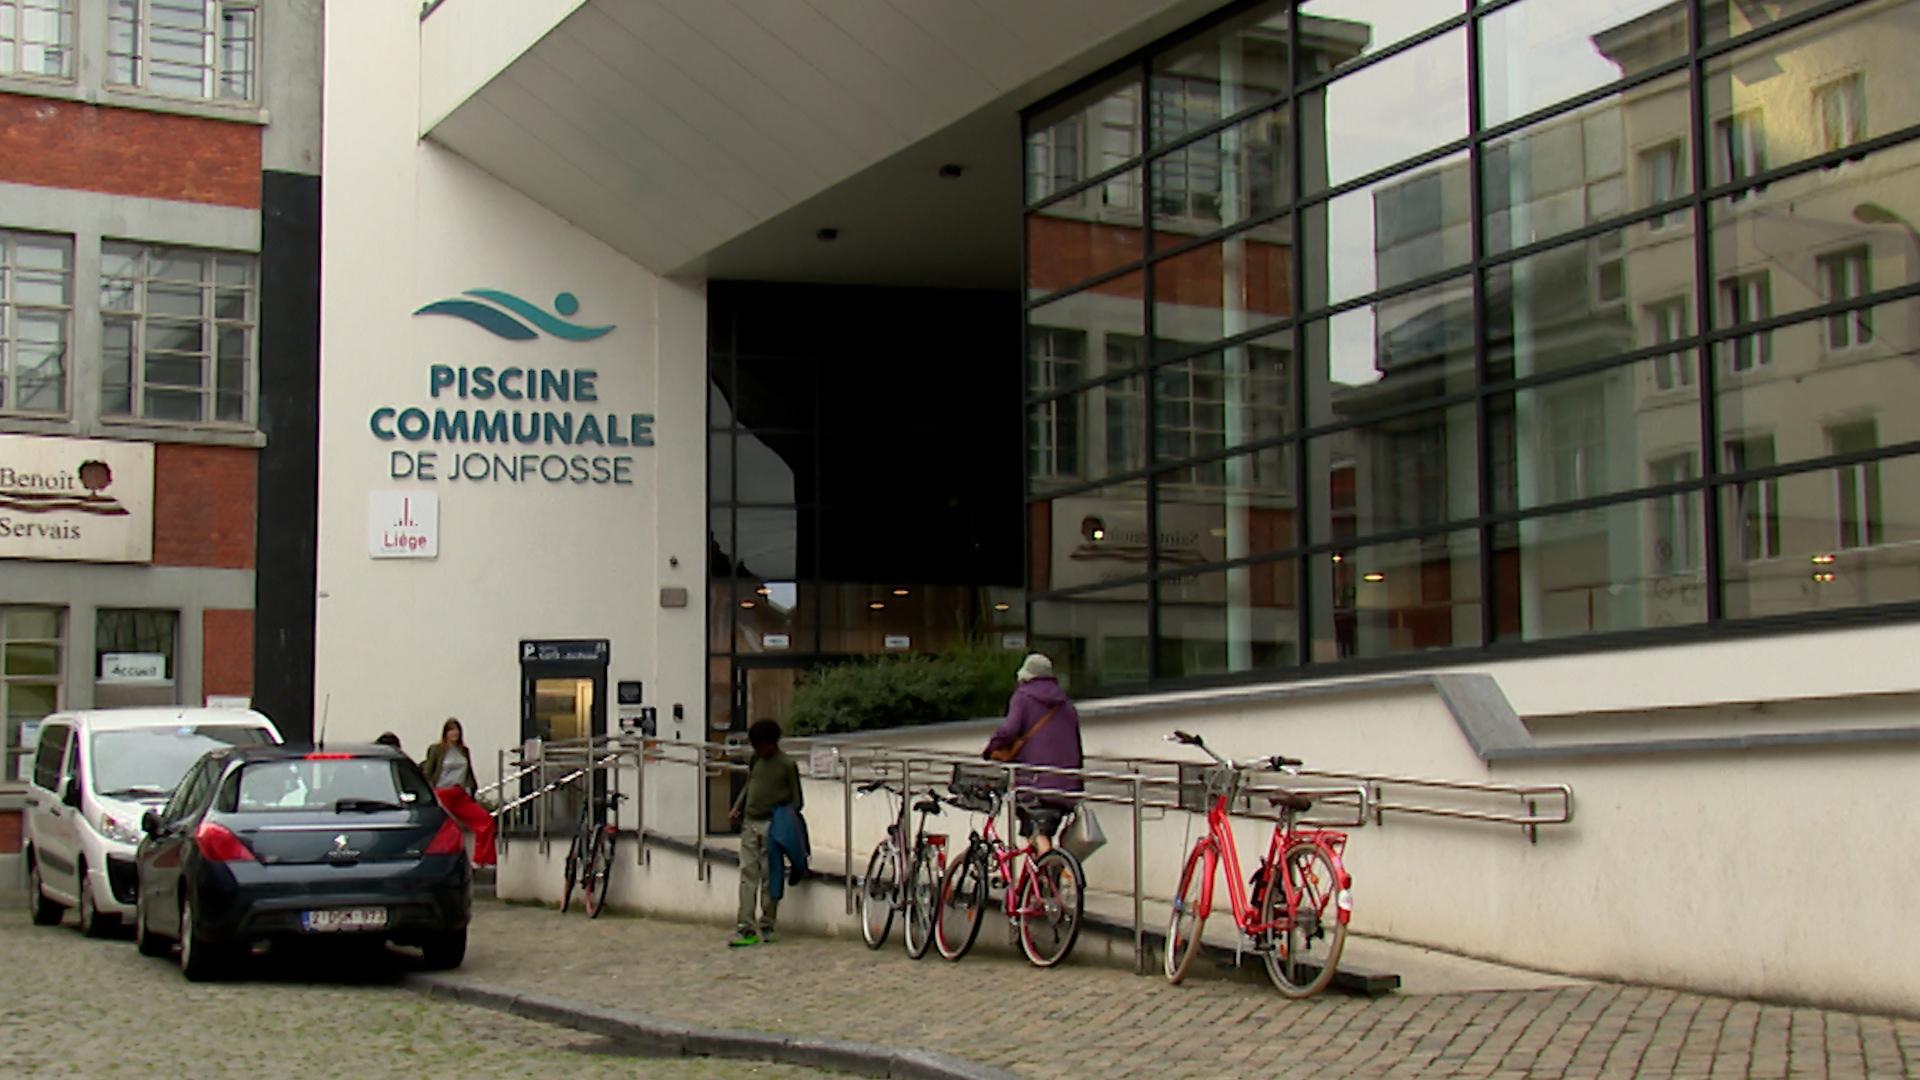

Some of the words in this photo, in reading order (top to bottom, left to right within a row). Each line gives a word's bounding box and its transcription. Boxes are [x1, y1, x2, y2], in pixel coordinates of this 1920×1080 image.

[429, 364, 598, 401] PISCINE
[369, 407, 655, 447] COMMUNALE
[390, 450, 437, 480] DE
[448, 452, 633, 484] JONFOSSE
[0, 517, 81, 540] Servais
